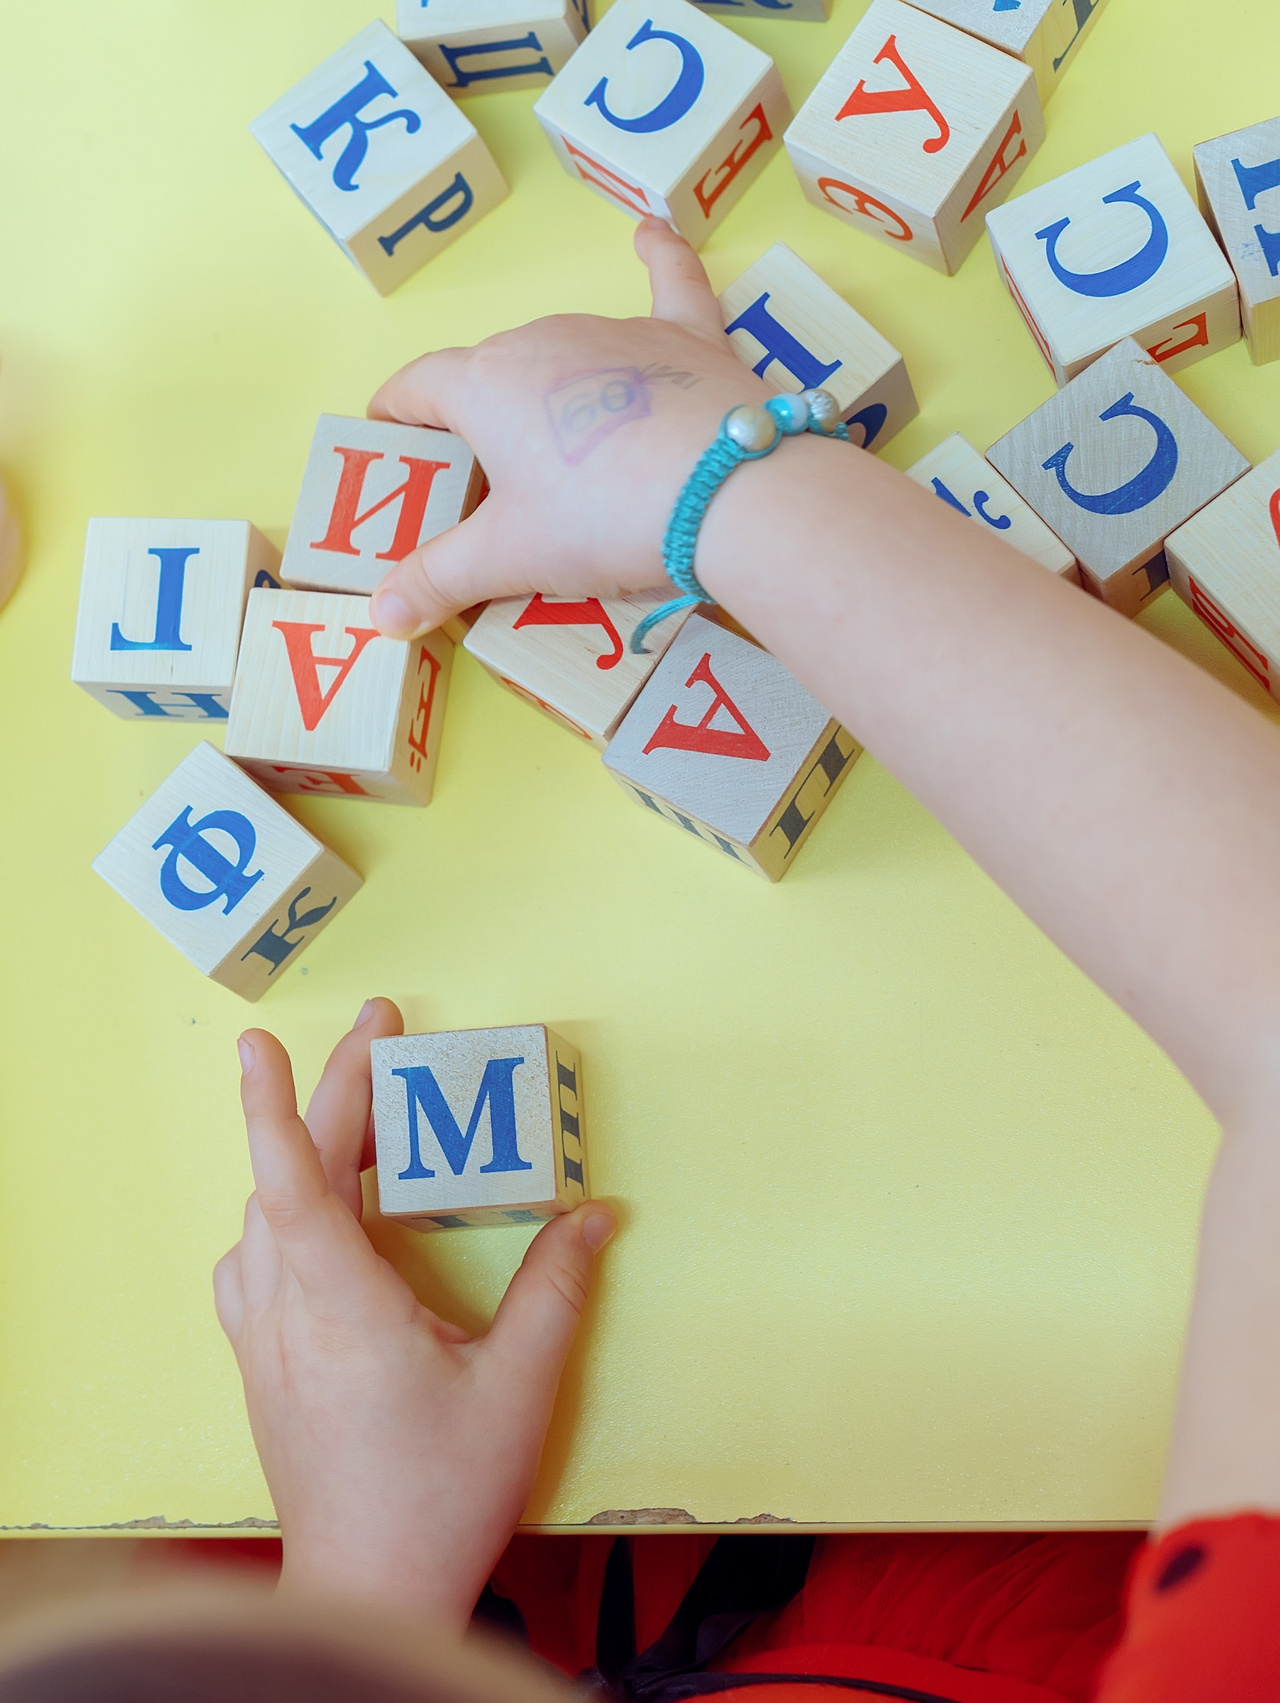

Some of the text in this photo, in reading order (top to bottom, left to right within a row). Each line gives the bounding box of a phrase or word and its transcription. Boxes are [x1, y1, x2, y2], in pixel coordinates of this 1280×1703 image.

[290, 60, 421, 193] К
[583, 18, 705, 134] С
[835, 34, 950, 154] У
[377, 171, 475, 258] Р
[693, 101, 773, 220] Е
[817, 176, 914, 242] Э
[960, 109, 1028, 223] А
[1034, 180, 1169, 298] С
[309, 446, 451, 562] И
[1041, 391, 1178, 515] С
[110, 547, 200, 651] Г
[106, 689, 229, 719] Н
[271, 620, 382, 732] А
[642, 652, 772, 763] А
[769, 724, 855, 860] П
[152, 804, 265, 916] Ф
[240, 886, 338, 977] К
[391, 1056, 532, 1181] М
[555, 1050, 586, 1197] Ш
